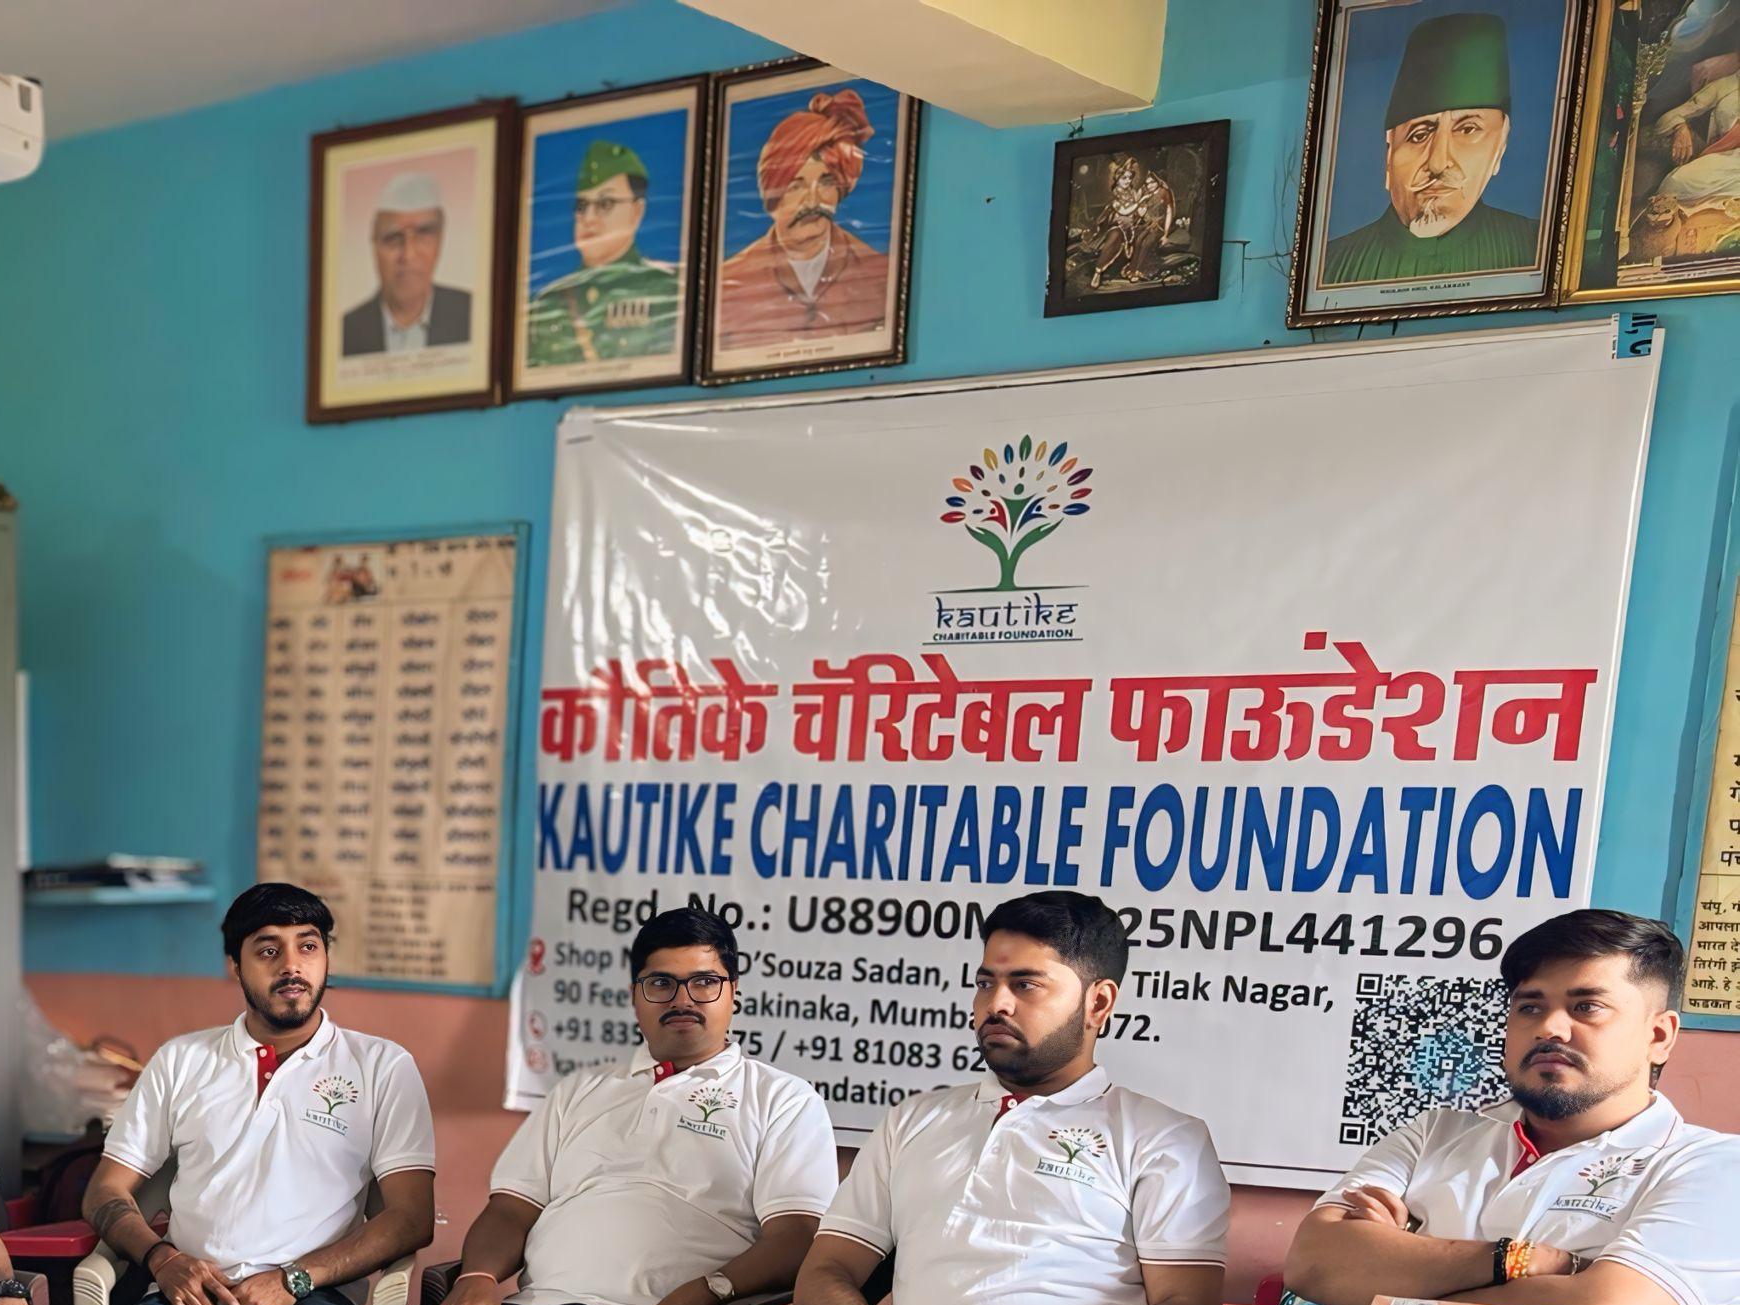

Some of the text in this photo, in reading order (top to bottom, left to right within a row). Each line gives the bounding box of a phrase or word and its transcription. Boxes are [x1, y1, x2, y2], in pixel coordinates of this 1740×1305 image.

[935, 592, 1079, 629] kautike
[998, 628, 1074, 640] FOUNDATION
[540, 630, 1599, 763] कौतिके चॅरिटेबल फाऊंडेशन
[538, 781, 1584, 901] KAUTIKE CHARITABLE FOUNDATION
[553, 980, 582, 1005] 90
[588, 980, 633, 1006] Fee
[554, 940, 613, 980] Shop
[851, 956, 950, 992] Sadan,
[1132, 970, 1211, 1002] Tilak
[1222, 973, 1334, 1013] Nagar,
[553, 1017, 593, 1042] +91
[793, 1034, 843, 1062] +91
[852, 1036, 942, 1069] 81083
